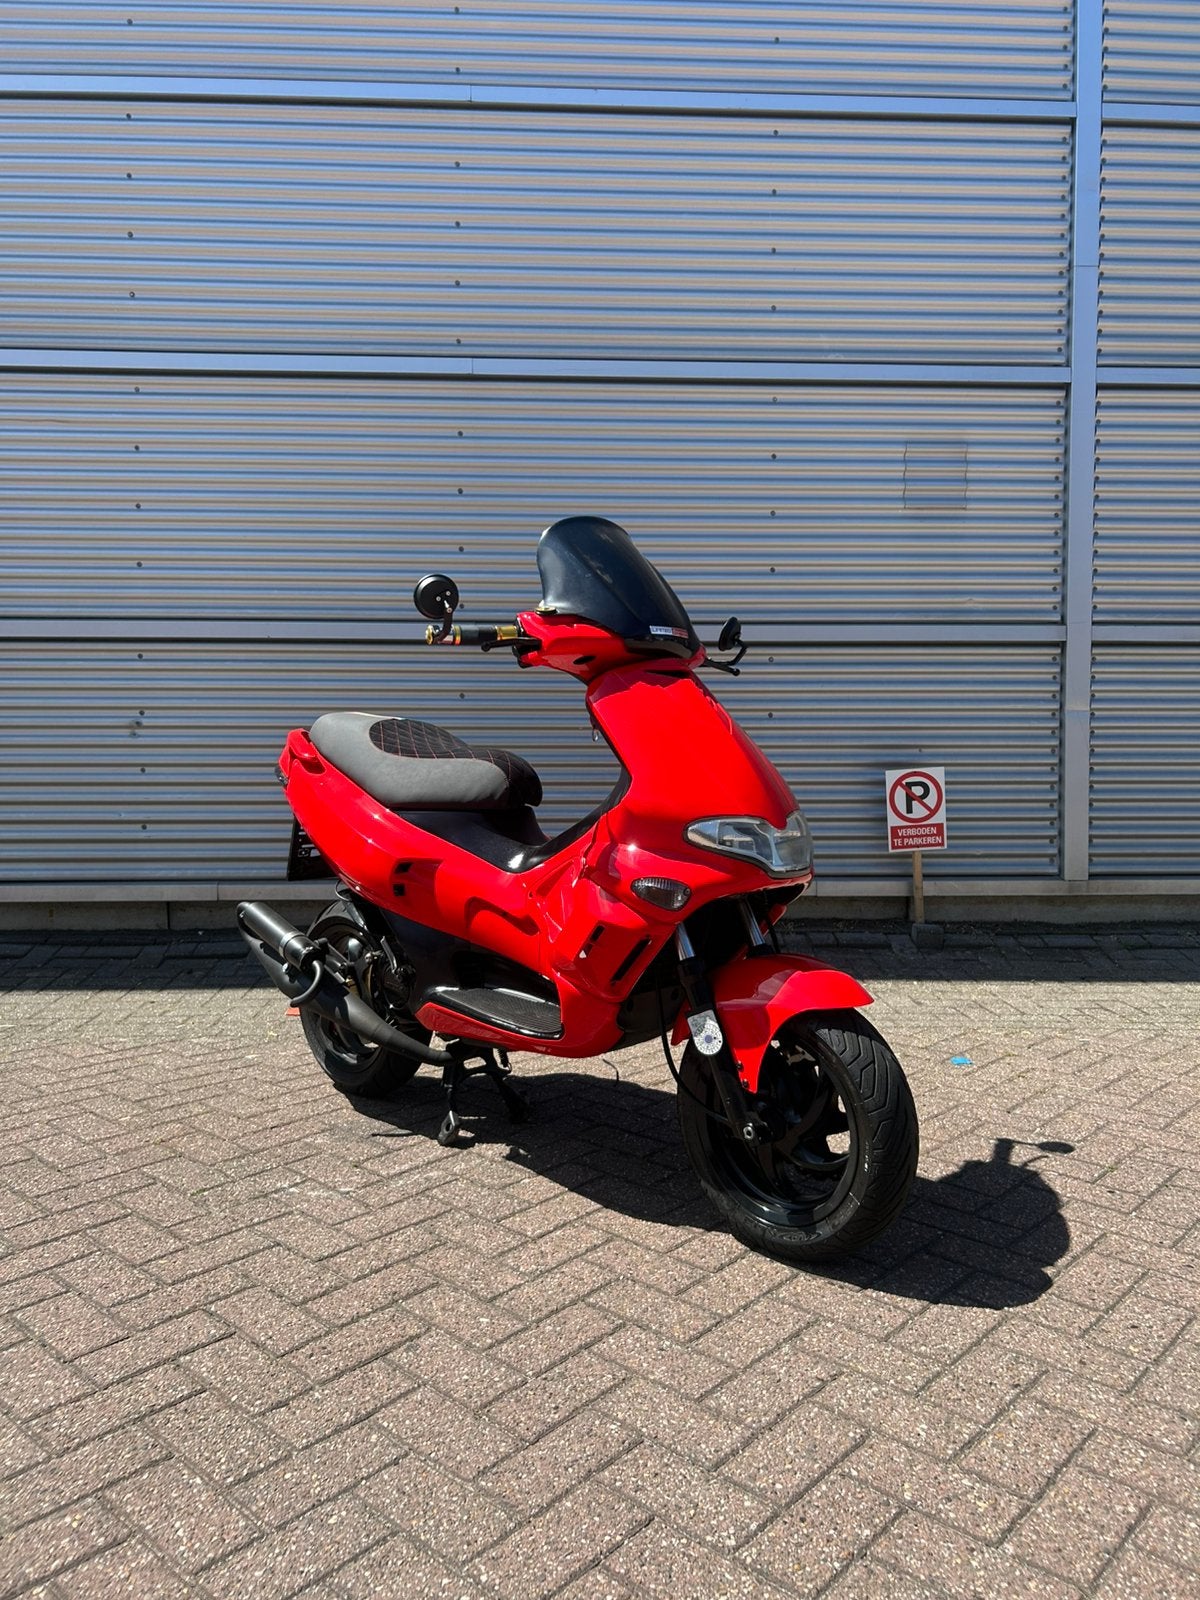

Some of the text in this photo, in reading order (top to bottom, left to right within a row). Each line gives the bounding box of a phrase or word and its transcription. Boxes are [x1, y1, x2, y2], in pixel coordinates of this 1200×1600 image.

[905, 781, 930, 814] P
[898, 827, 937, 836] VERBODEN
[893, 836, 942, 846] TE PARKEREN
